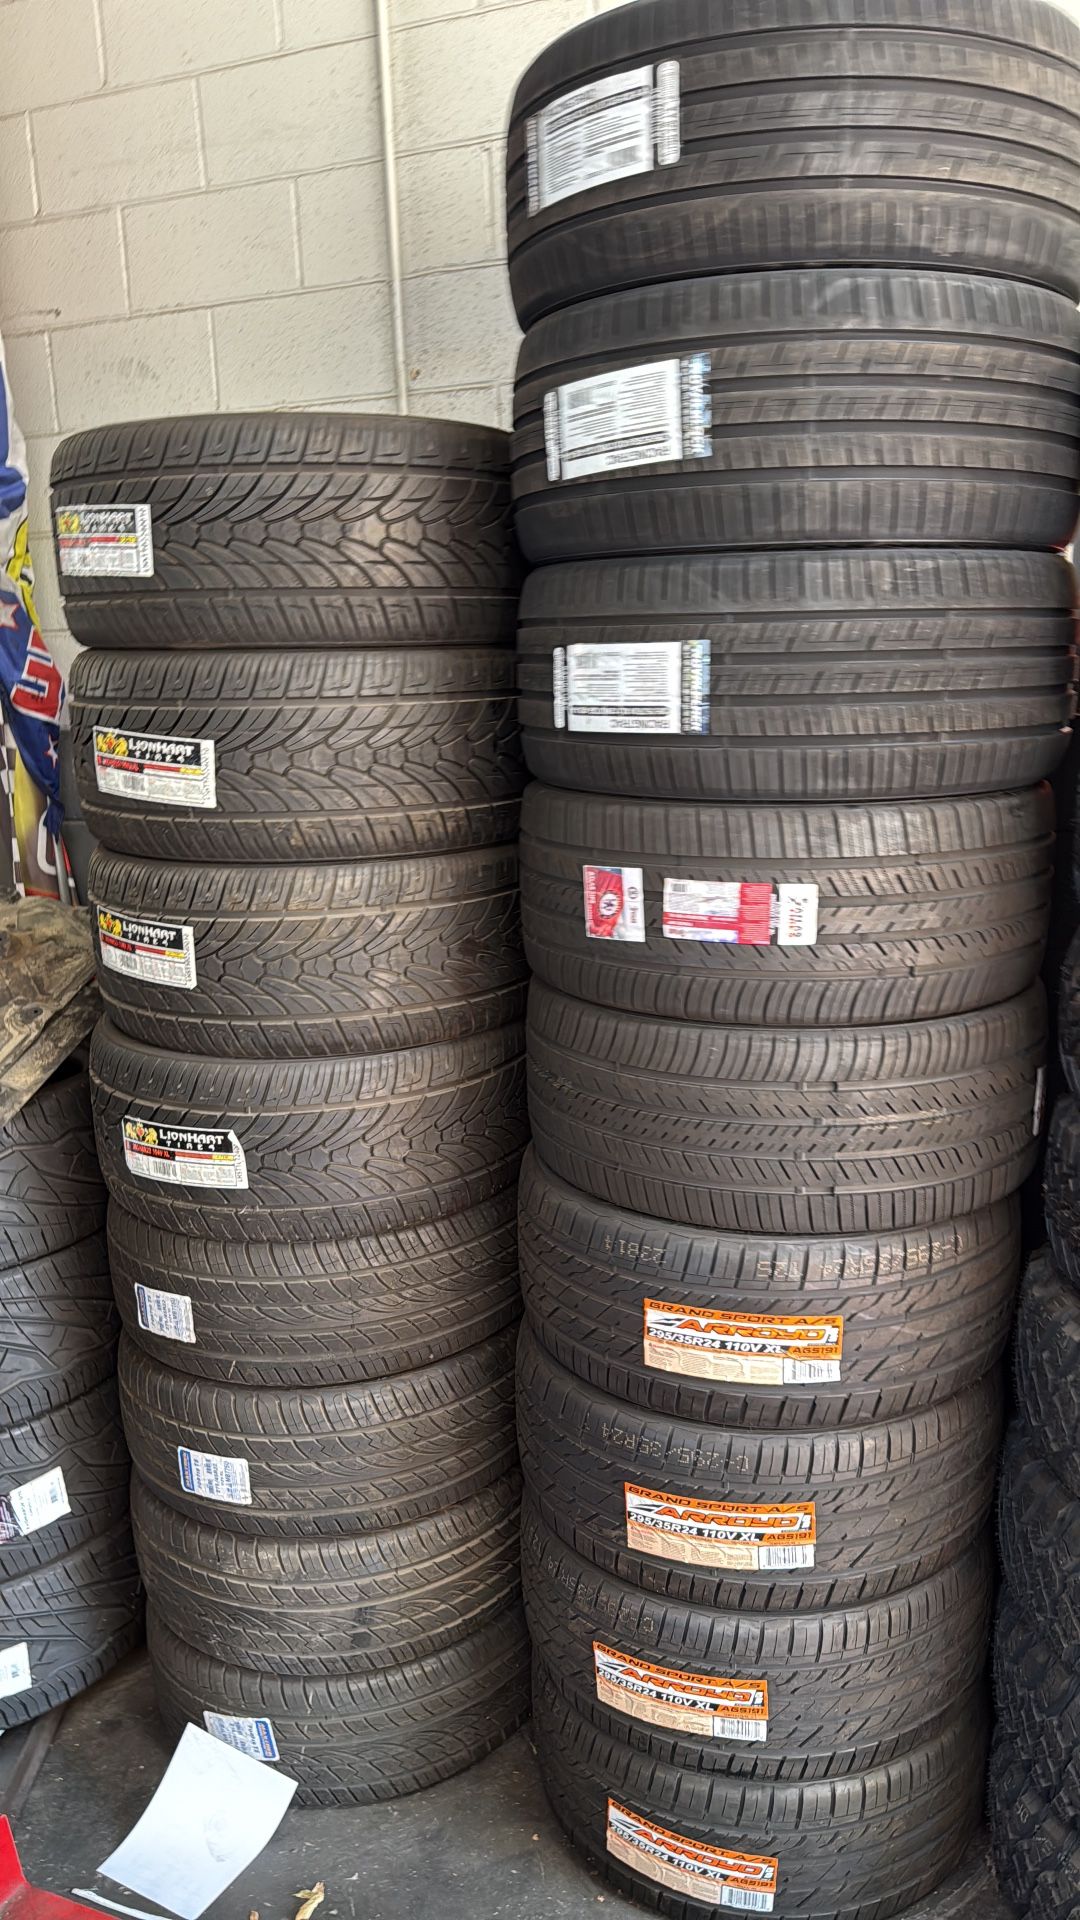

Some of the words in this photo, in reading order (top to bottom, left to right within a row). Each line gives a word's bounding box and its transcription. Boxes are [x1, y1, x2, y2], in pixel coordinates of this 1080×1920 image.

[128, 737, 195, 757] LIONHART
[122, 920, 177, 940] LIONHART
[128, 933, 169, 947] TIRES
[159, 1128, 225, 1145] LIONHART
[165, 1141, 216, 1152] TIRES
[648, 1301, 715, 1318] GRAND
[720, 1312, 791, 1325] SPORT
[793, 1316, 838, 1325] A/S
[648, 1327, 721, 1349] 295/35R24
[724, 1341, 763, 1353] 110V
[765, 1344, 783, 1354] XL
[676, 1318, 827, 1341] ARROYO
[791, 1346, 838, 1355] AGS191
[628, 1485, 691, 1506] GRAND
[696, 1500, 763, 1513] SPORT
[767, 1504, 810, 1513] A/S
[629, 1512, 698, 1536] 295/35R24
[701, 1528, 737, 1540] 110V
[739, 1532, 760, 1542] XL
[654, 1506, 800, 1528] ARROYO
[766, 1532, 812, 1541] AGS191
[596, 1643, 651, 1671] GRAND
[654, 1667, 717, 1686] SPORT
[721, 1680, 762, 1689] A/S
[598, 1668, 658, 1699] 295/35R24
[660, 1692, 695, 1707] 110V
[696, 1700, 716, 1711] XL
[618, 1667, 752, 1702] ARROYO
[610, 1801, 665, 1835] GRAND
[669, 1831, 729, 1857] SPORT
[734, 1854, 773, 1864] A/S
[610, 1823, 669, 1862] 295/35R24
[672, 1857, 705, 1875] 110V
[706, 1870, 725, 1881] XL
[631, 1828, 763, 1876] ARROYO
